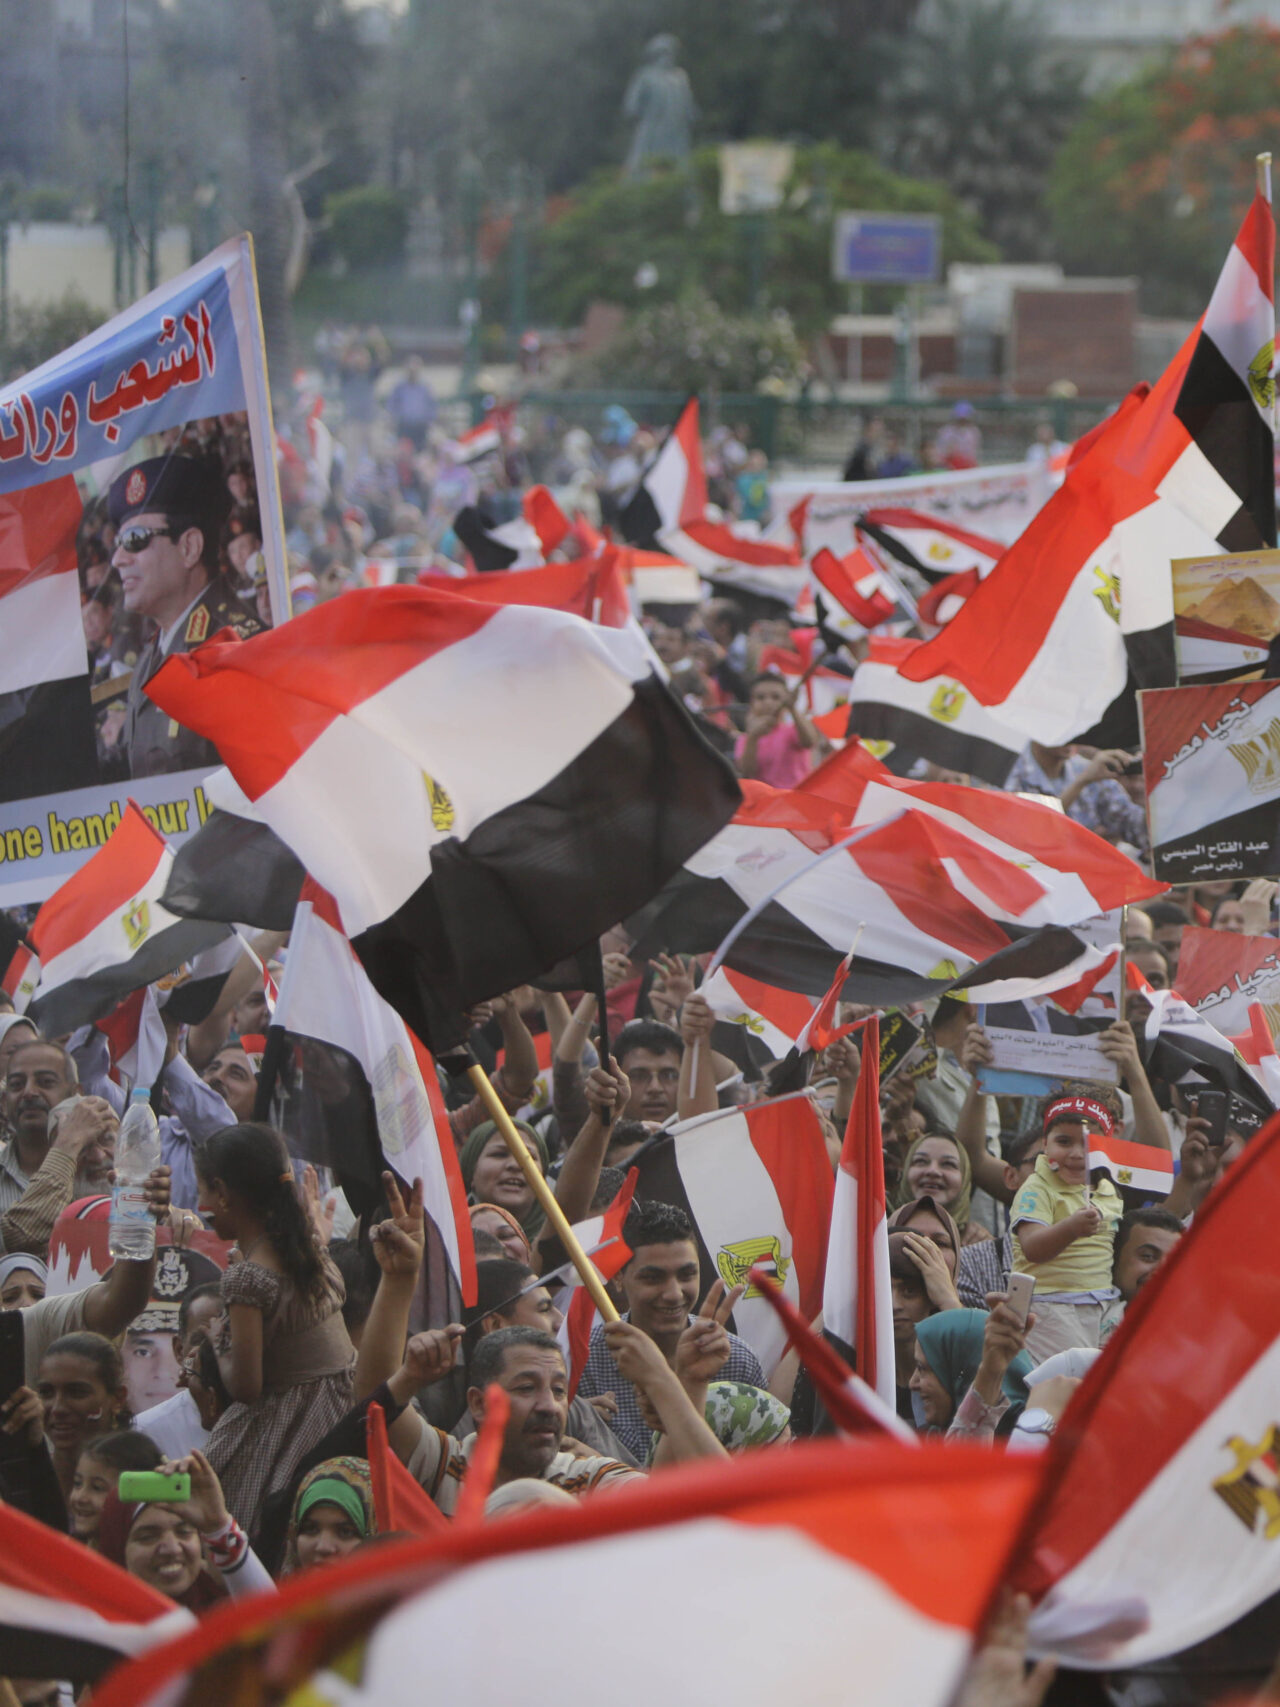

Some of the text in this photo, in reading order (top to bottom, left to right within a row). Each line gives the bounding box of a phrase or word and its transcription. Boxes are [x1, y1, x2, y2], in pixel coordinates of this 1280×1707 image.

[86, 299, 216, 443] الشعب
[1161, 697, 1252, 780] تحيا مصر
[47, 800, 122, 854] hand
[1208, 841, 1243, 859] الفتاح
[1245, 841, 1270, 855] عبد
[1190, 858, 1244, 875] رئيس مصر
[1194, 983, 1232, 1013] مص
[1018, 1191, 1038, 1214] 5
